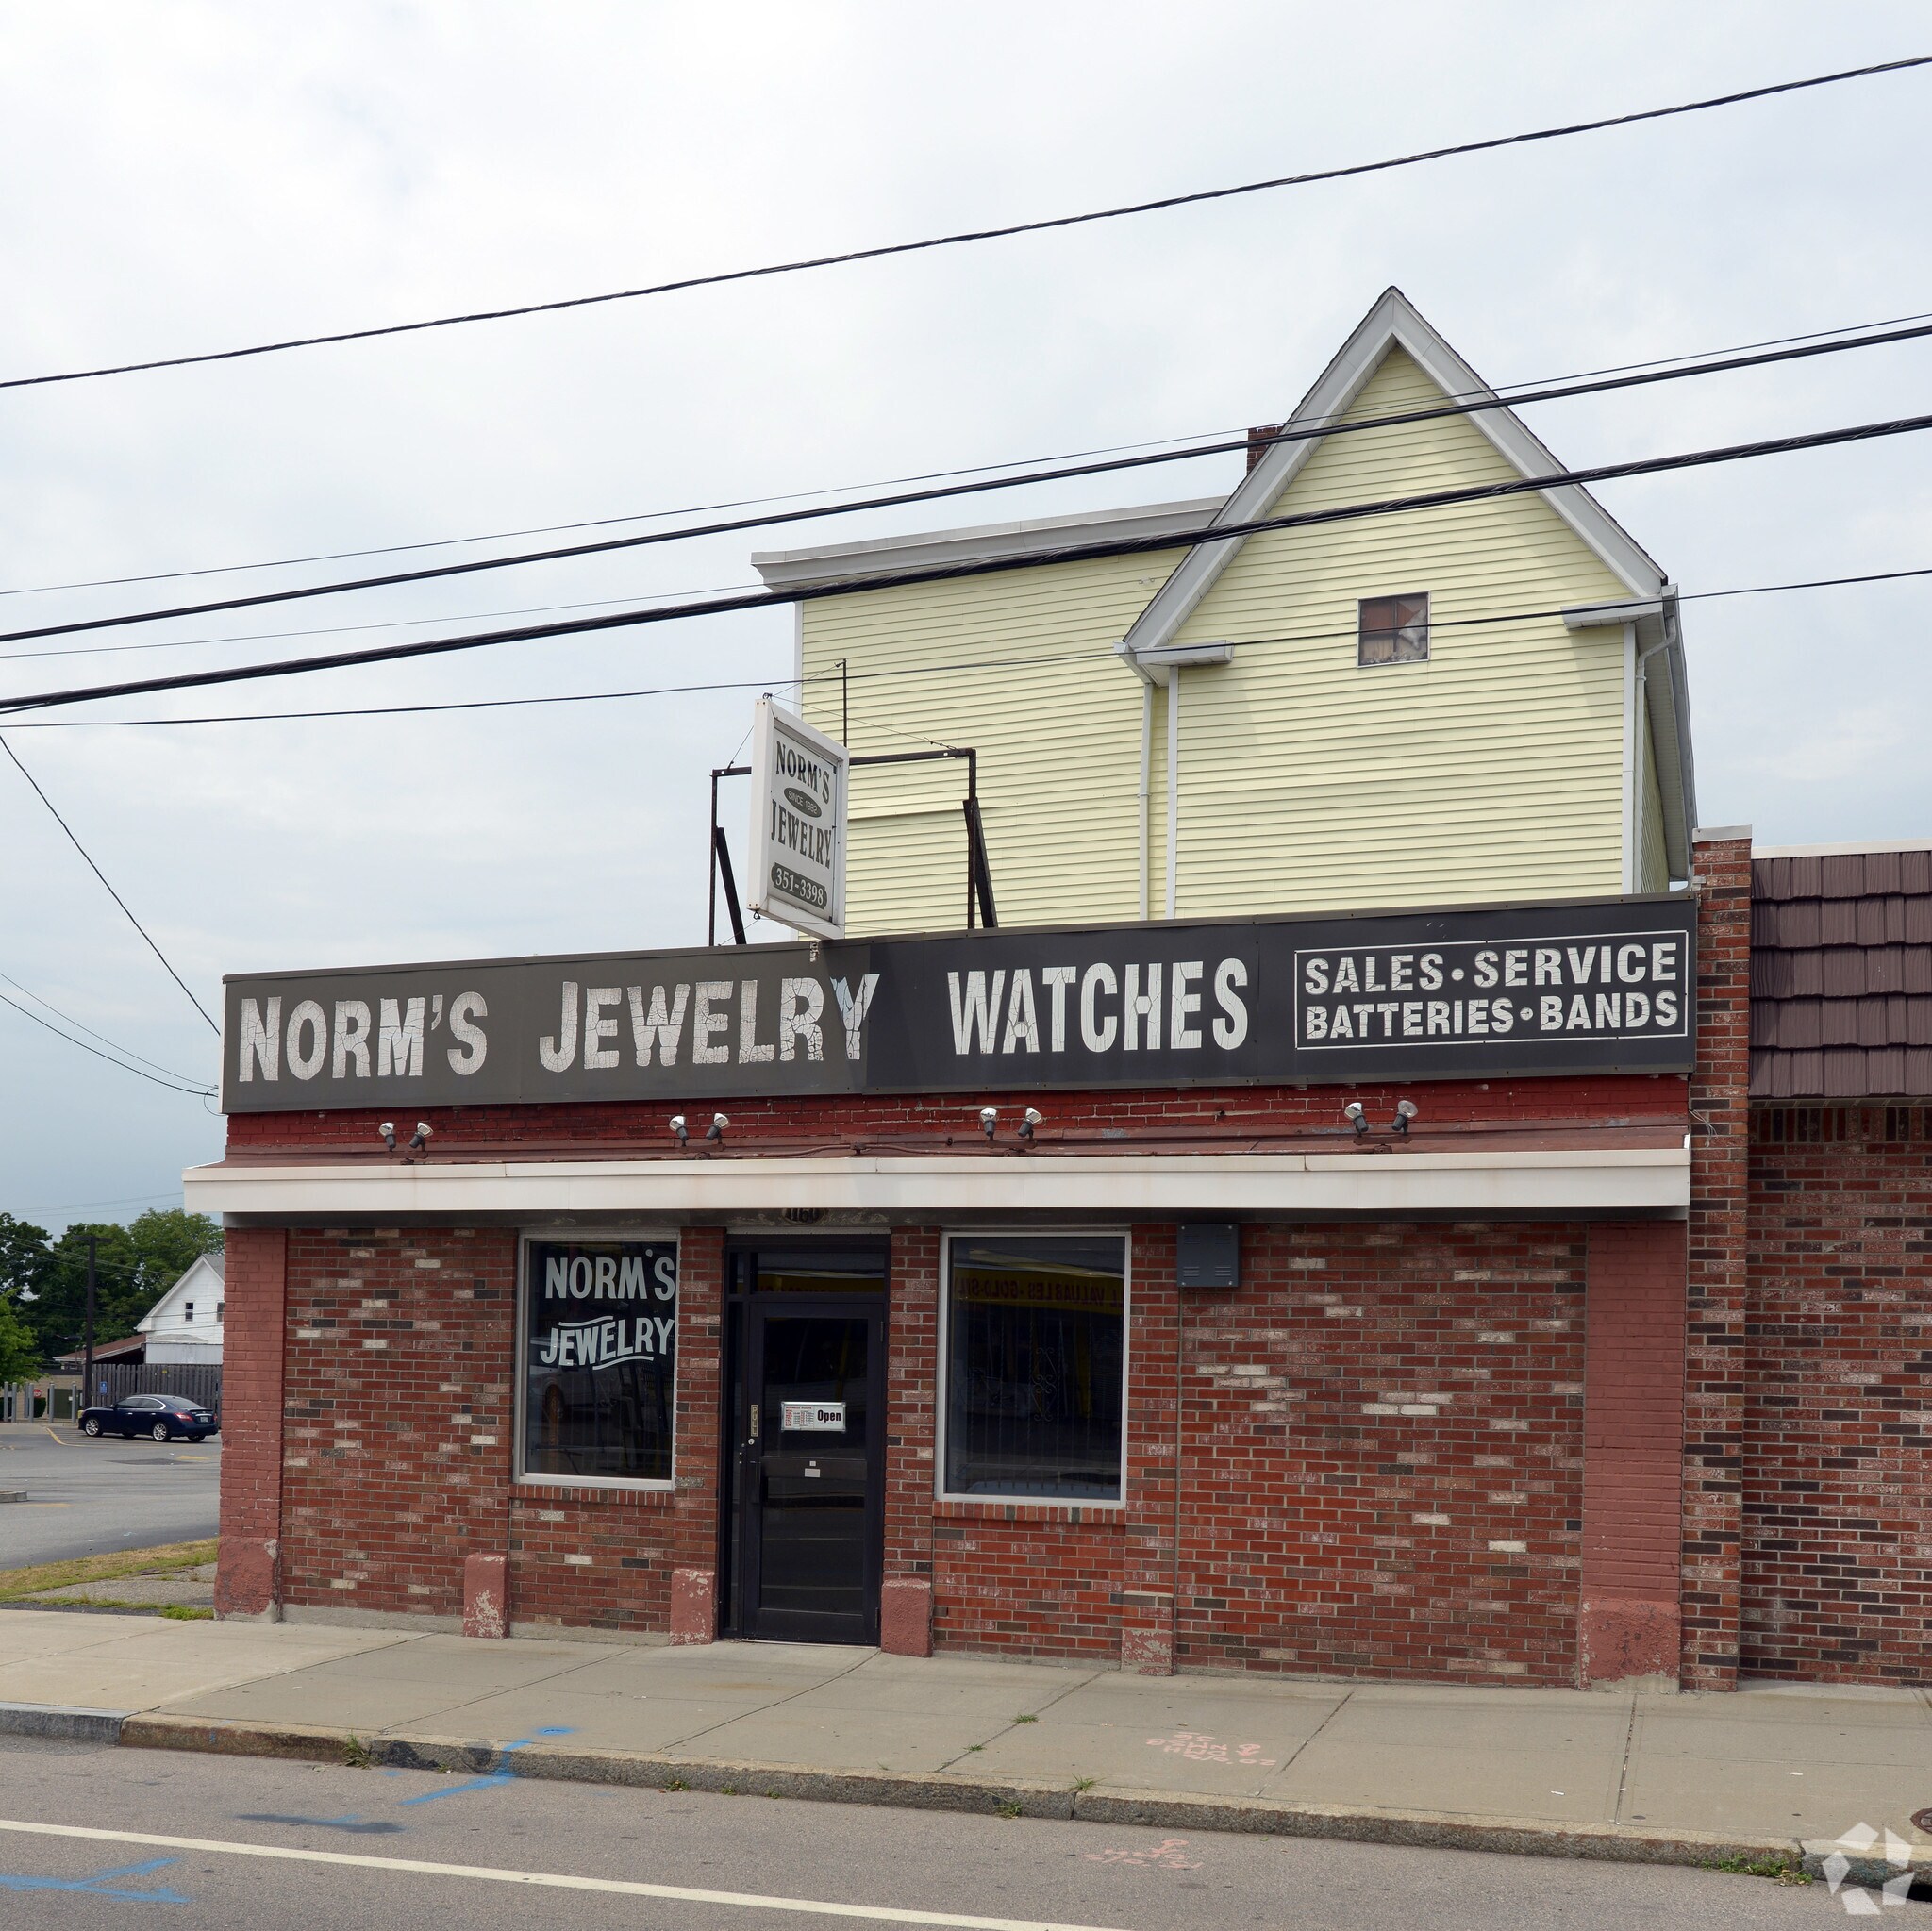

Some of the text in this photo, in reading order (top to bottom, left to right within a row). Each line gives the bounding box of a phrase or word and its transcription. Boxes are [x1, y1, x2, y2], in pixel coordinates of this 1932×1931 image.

[776, 741, 830, 805] NORM'S
[788, 791, 804, 807] SINCE
[771, 799, 832, 870] JEWELRY
[774, 867, 824, 907] 351-3398
[238, 973, 880, 1083] NORM'S JEWELRY
[948, 957, 1248, 1056] WATCHES
[545, 1249, 675, 1301] NORM'S
[540, 1317, 675, 1367] JEWELRY
[817, 1409, 841, 1423] Open
